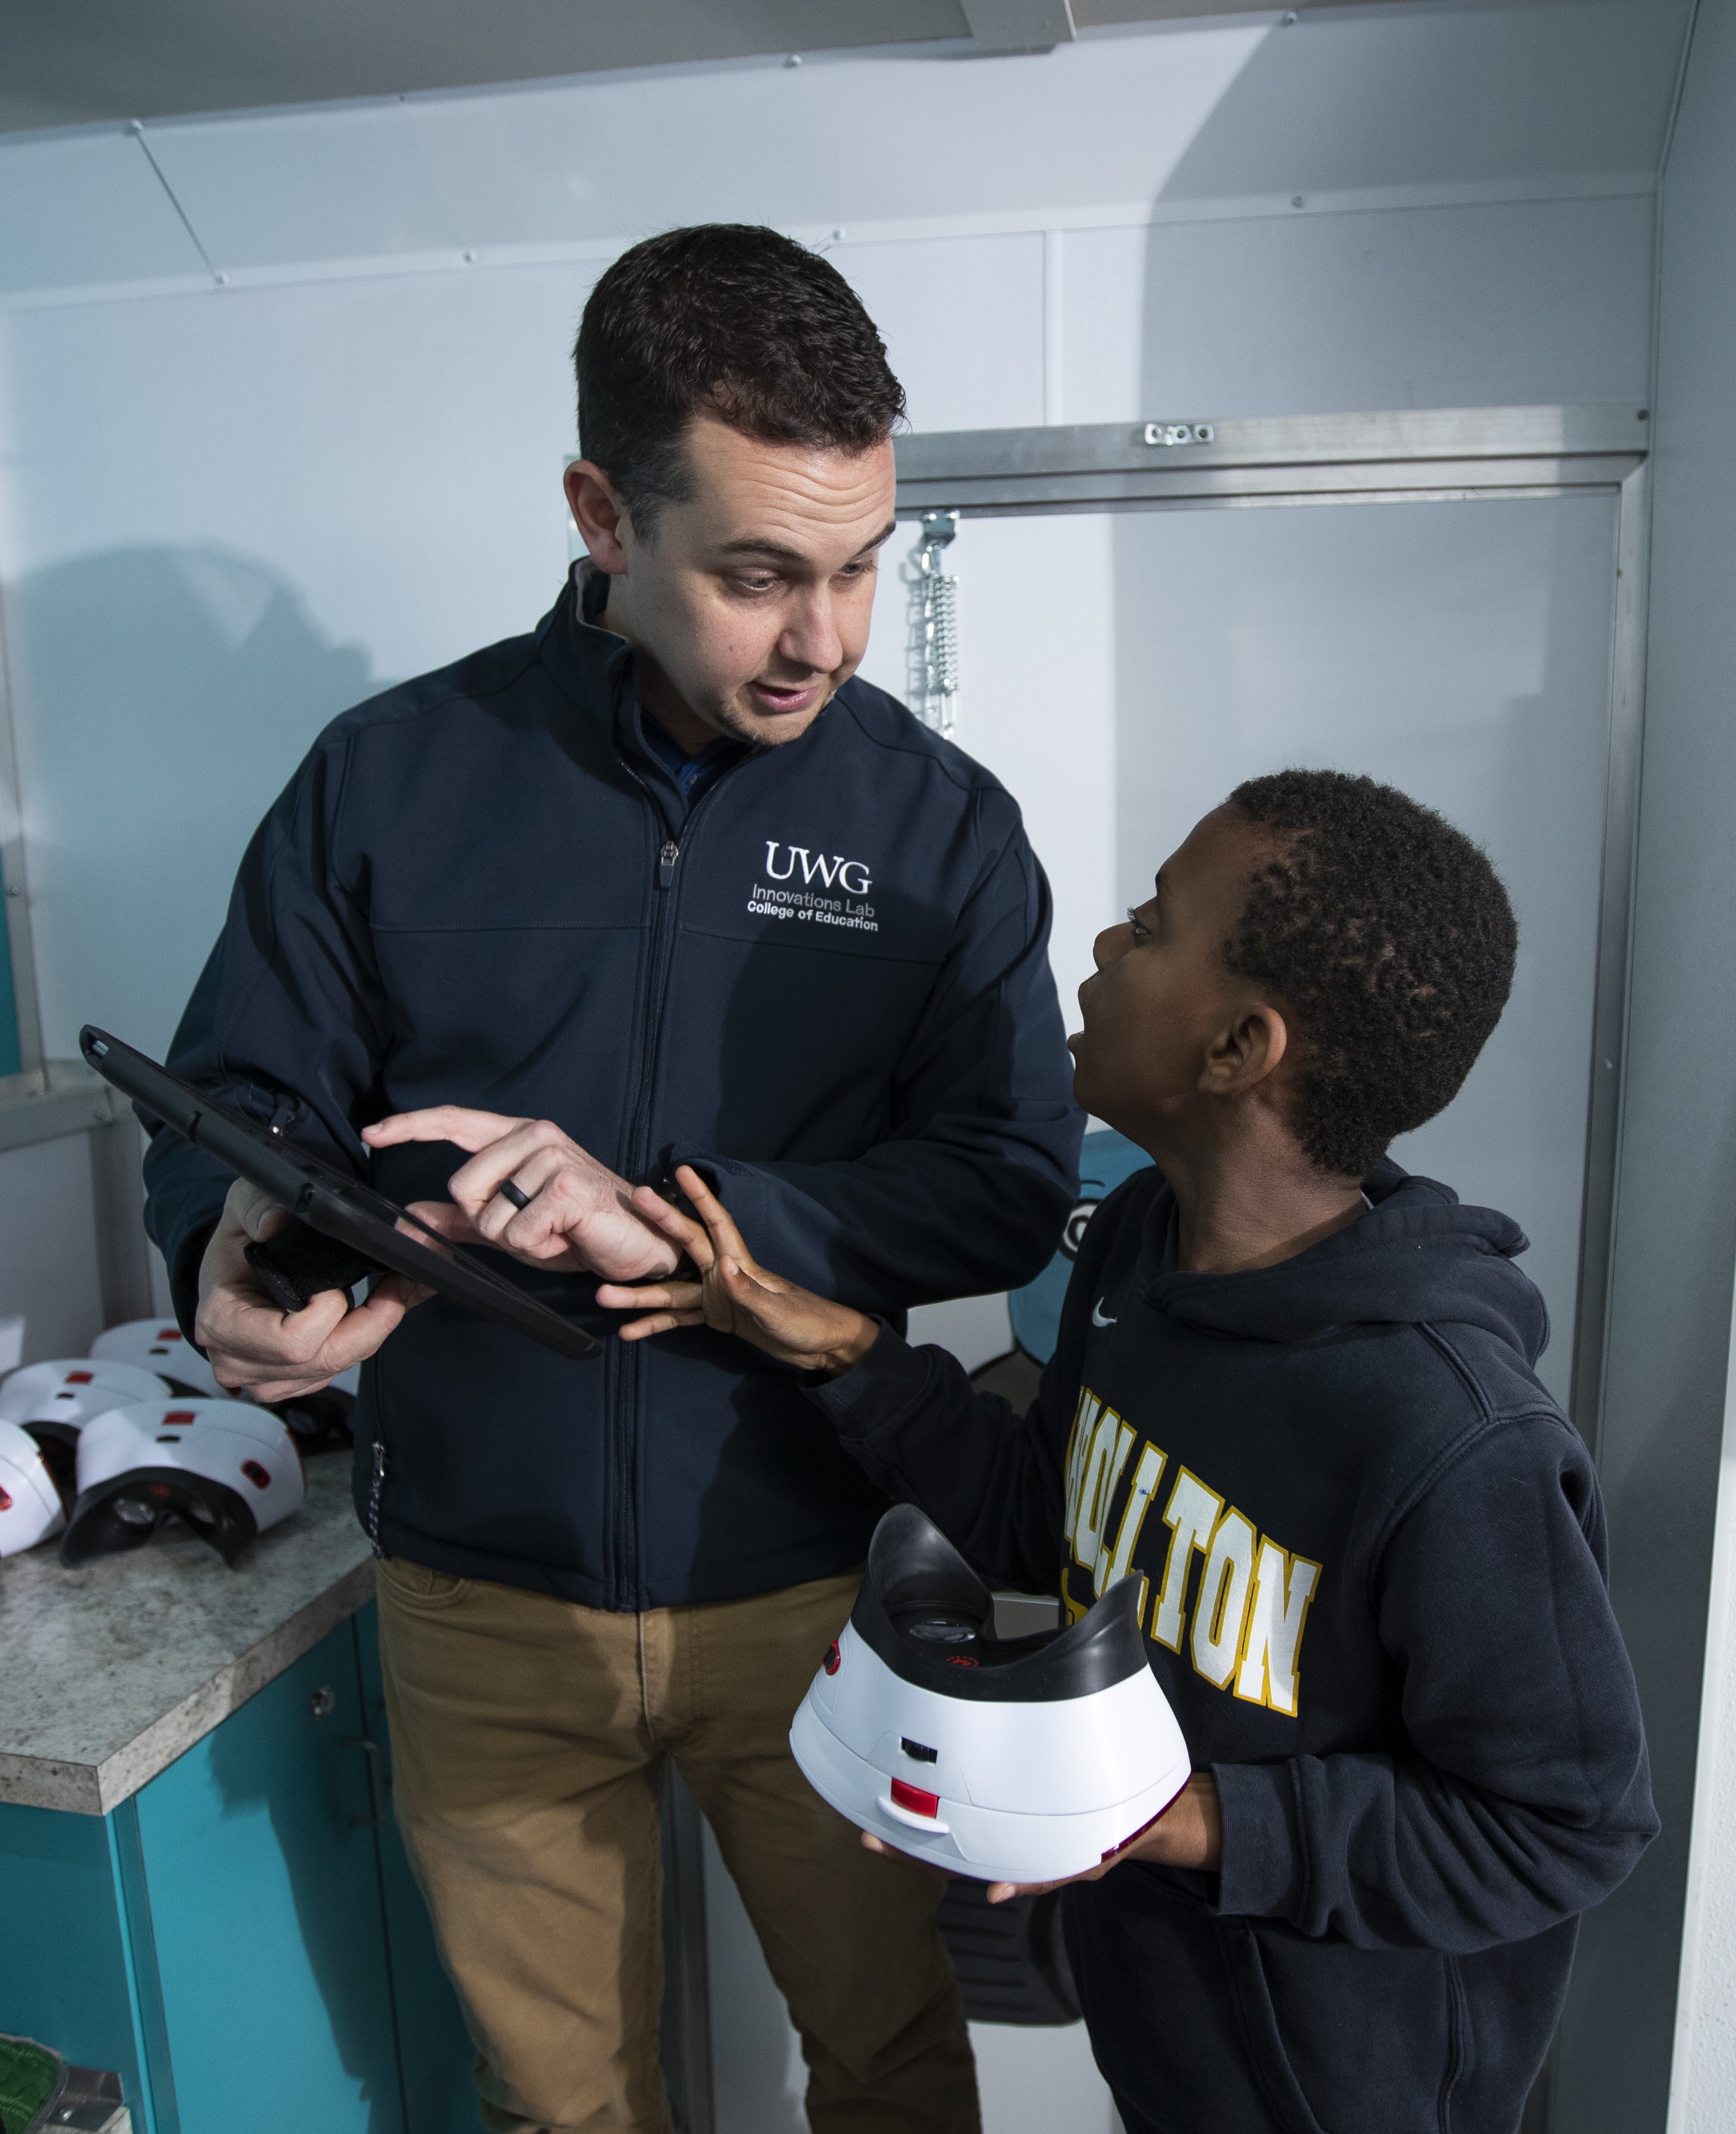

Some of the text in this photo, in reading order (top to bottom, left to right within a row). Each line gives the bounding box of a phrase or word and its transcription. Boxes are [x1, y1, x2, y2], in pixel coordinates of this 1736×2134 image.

[766, 841, 873, 894] UWG
[748, 900, 878, 931] College of Education
[753, 883, 874, 918] Innovations Lab
